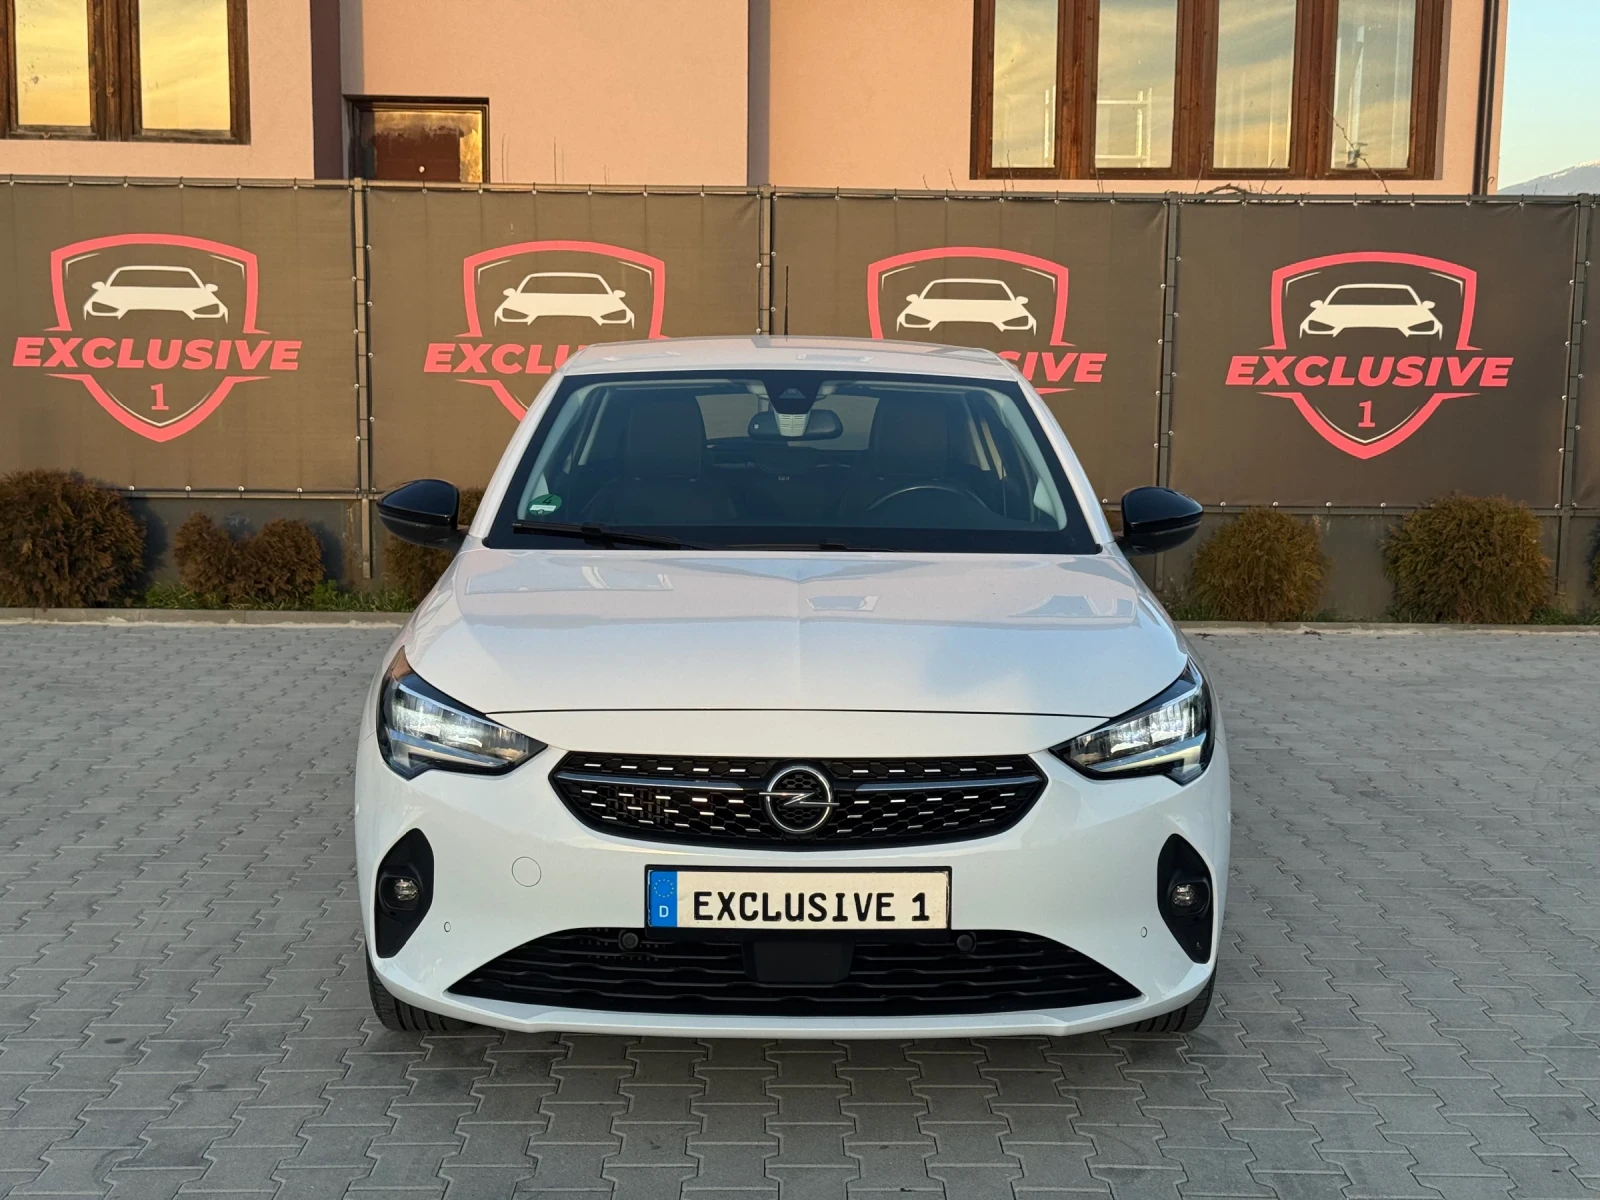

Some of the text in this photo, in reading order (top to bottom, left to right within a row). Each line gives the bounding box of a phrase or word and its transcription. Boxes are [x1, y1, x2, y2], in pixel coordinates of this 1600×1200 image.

[12, 337, 302, 371] EXCLUSIVE
[1225, 355, 1514, 388] EXCLUSIVE
[150, 383, 169, 411] 1
[1357, 400, 1376, 428] 1
[658, 905, 670, 918] D
[693, 891, 930, 922] EXCLUSIVE 1
